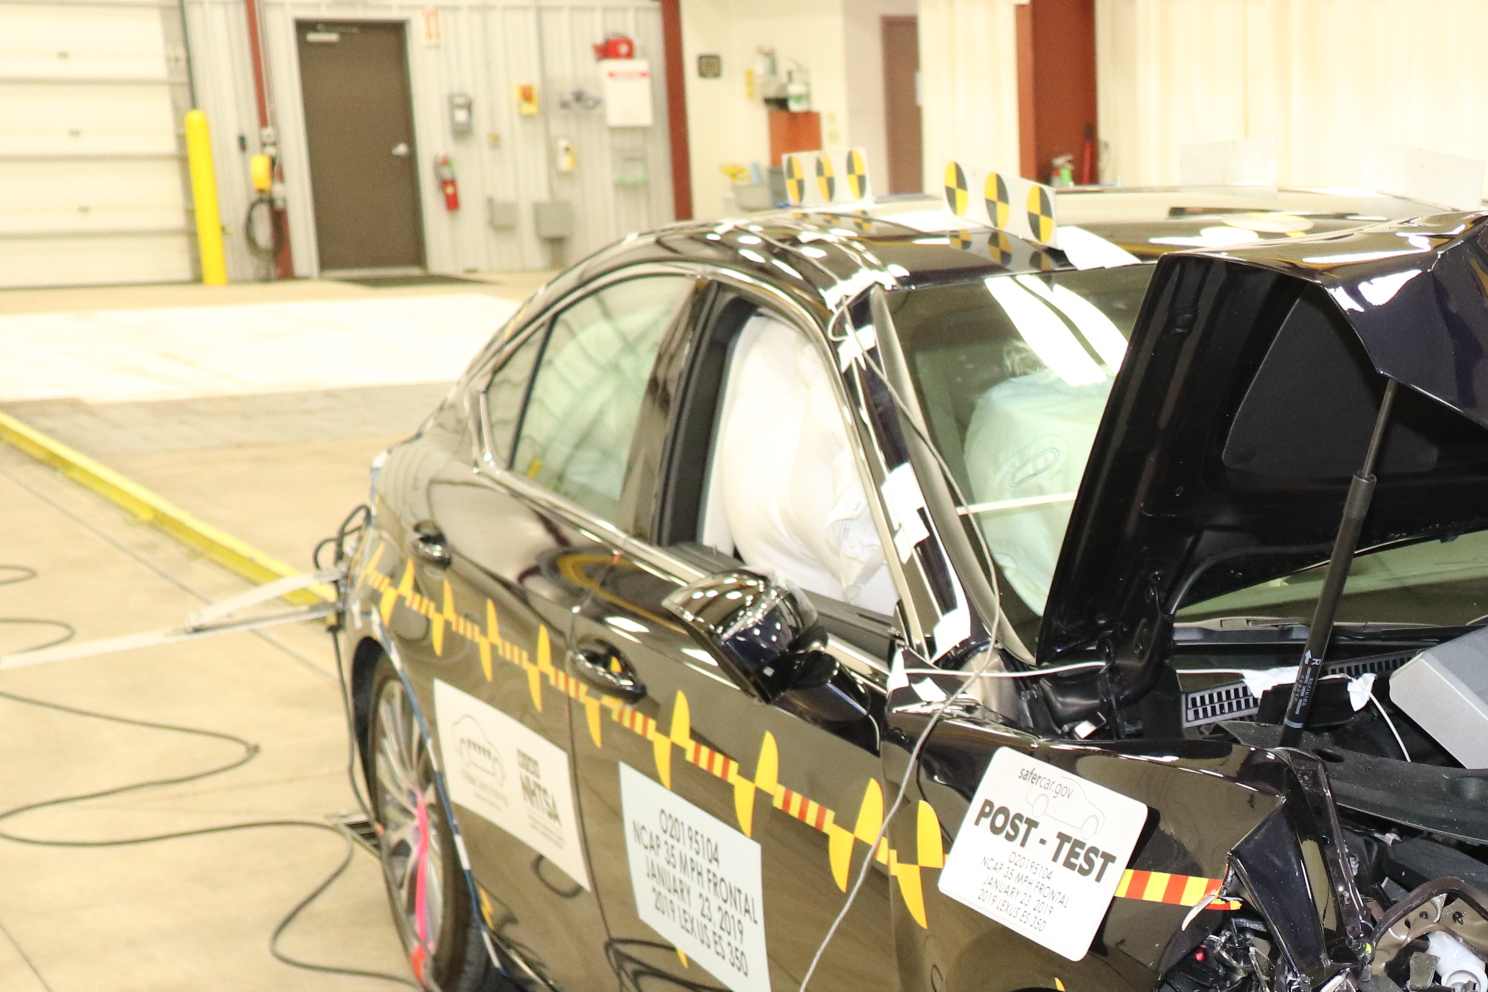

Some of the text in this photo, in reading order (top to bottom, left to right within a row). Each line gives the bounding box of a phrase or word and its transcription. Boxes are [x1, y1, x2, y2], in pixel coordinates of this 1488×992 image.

[1018, 767, 1075, 799] safercar.gov
[632, 818, 758, 925] NCAP 35 MPH FRONTAL
[973, 798, 1040, 849] POST
[1051, 831, 1118, 884] TEST
[646, 855, 692, 907] JANUARY
[718, 904, 744, 944] 2019
[977, 888, 1047, 932] 2019 LEXUS ES 350
[980, 855, 1070, 909] NCAP 35 MPH FRONTAL
[983, 874, 1021, 900] JANUARY
[1032, 897, 1054, 917] 2019
[652, 886, 748, 977] 2019 LEXUS ES 350
